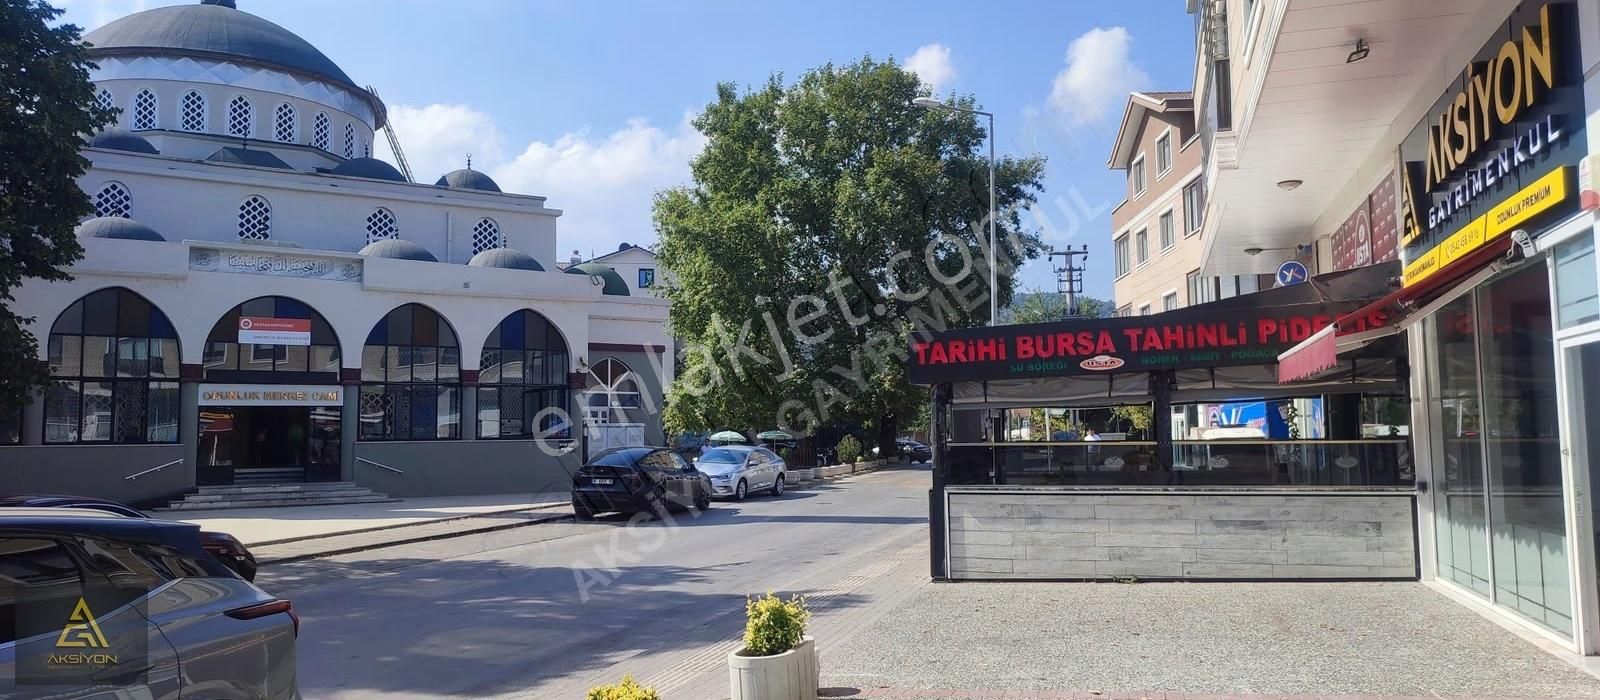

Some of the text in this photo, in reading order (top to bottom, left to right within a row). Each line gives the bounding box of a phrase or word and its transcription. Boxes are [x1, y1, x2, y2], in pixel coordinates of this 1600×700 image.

[1425, 4, 1552, 194] AKSİYON
[1428, 114, 1562, 230] GAYRİMENKUL
[1016, 330, 1116, 360] BURSA
[1010, 363, 1025, 373] SU
[202, 390, 260, 401] ODUNLUK
[263, 391, 309, 402] MERKEZ
